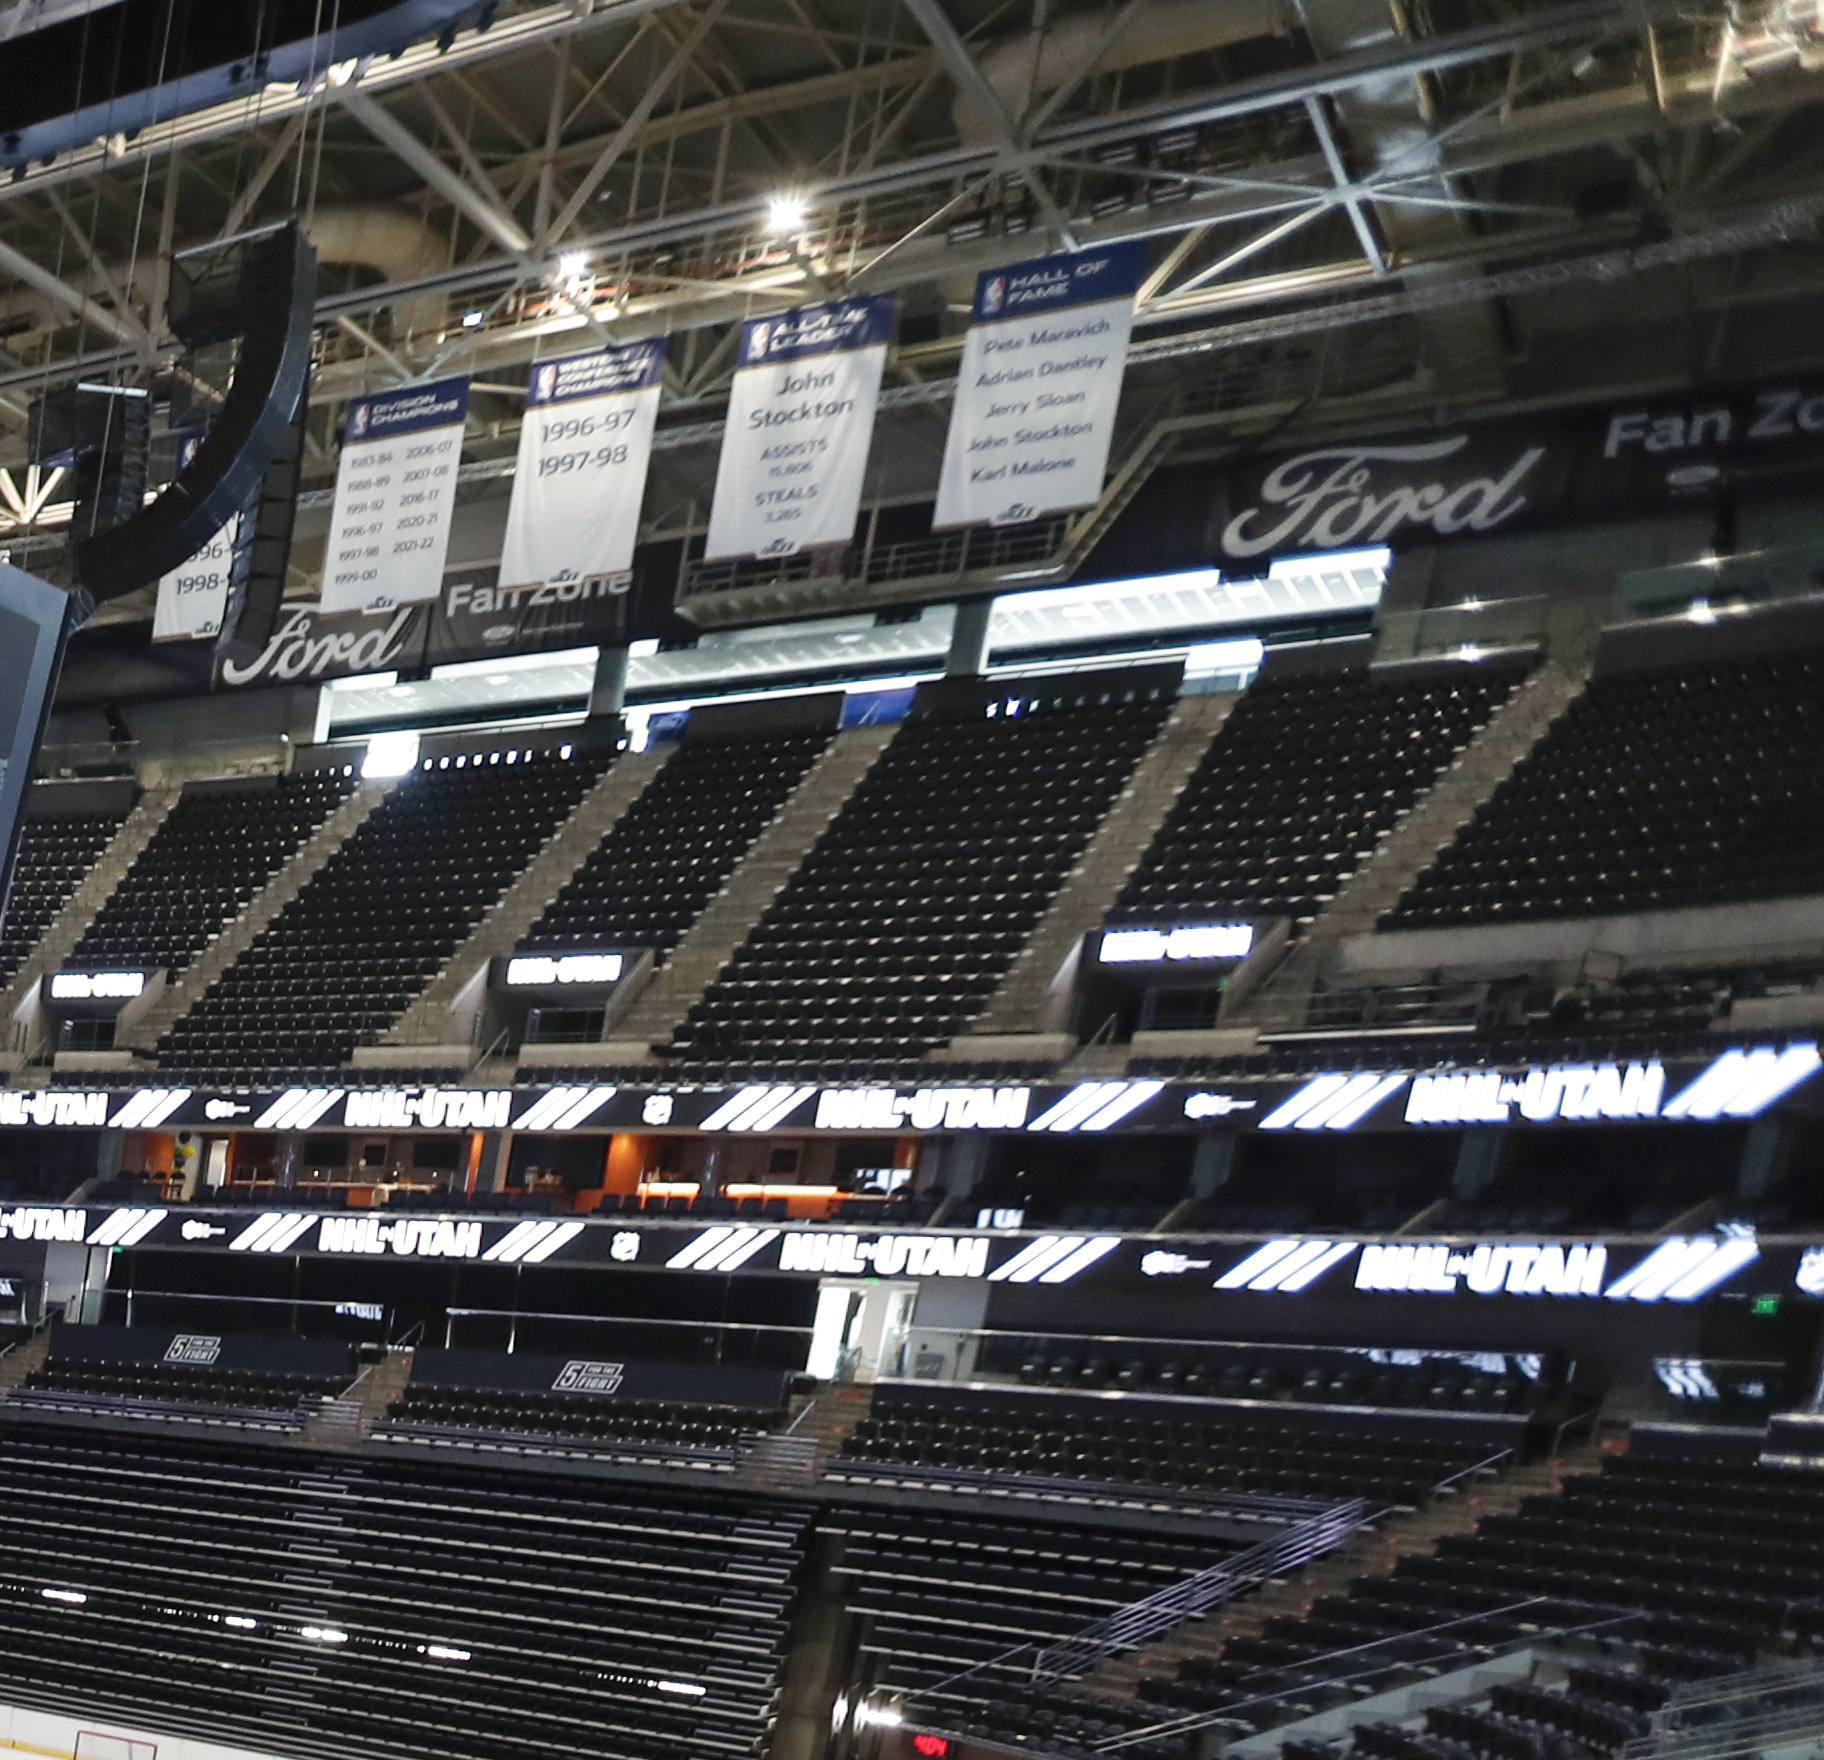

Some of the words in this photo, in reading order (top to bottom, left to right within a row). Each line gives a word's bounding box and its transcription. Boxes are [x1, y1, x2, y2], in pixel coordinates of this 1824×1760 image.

[1008, 268, 1070, 291] HALL
[1074, 259, 1110, 279] OF
[1007, 281, 1070, 305] FAME
[1029, 319, 1110, 346] Maravich
[775, 370, 835, 396] John
[975, 367, 1034, 388] Adrian
[541, 408, 638, 443] 1996-97
[748, 399, 854, 430] Stockton
[1014, 422, 1094, 445] Stockton
[537, 444, 628, 477] 1997-98
[1221, 434, 1546, 558] Ford
[1603, 409, 1732, 458] Fan
[223, 602, 415, 684] Ford
[344, 1091, 413, 1126] NHL
[814, 1088, 904, 1128] NHL
[1405, 1072, 1510, 1124] NHL
[318, 1218, 386, 1253] NHL
[779, 1232, 866, 1273] NHL
[1355, 1243, 1457, 1293] NHL
[170, 1338, 188, 1358] 5
[560, 1365, 582, 1386] 5
